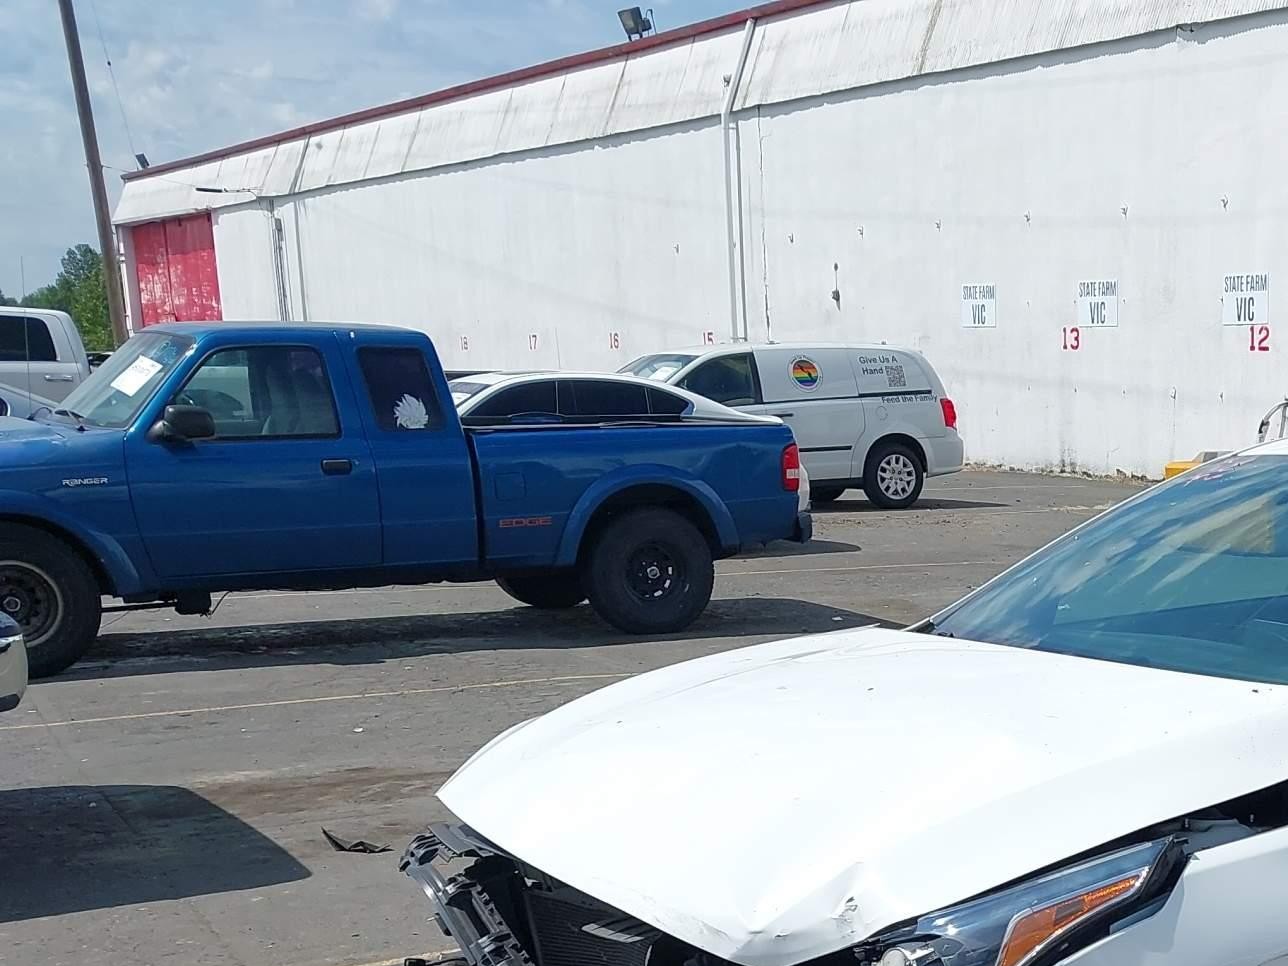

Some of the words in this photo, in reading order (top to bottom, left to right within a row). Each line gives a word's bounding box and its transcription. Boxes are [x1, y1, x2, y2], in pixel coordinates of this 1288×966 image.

[1079, 282, 1096, 297] STATE
[1099, 281, 1116, 296] FARM
[1224, 276, 1244, 292] STATE
[1246, 274, 1267, 291] FARM
[963, 286, 978, 299] STATE
[979, 285, 995, 299] FARM
[972, 304, 986, 324] VIC
[1090, 301, 1106, 324] VIC
[1236, 297, 1255, 321] VIC
[529, 335, 538, 350] 17
[609, 333, 619, 349] 16
[1063, 327, 1080, 350] 13
[1249, 326, 1270, 351] 12
[858, 356, 877, 364] Give
[879, 355, 890, 363] Us
[862, 367, 884, 375] Hand
[881, 395, 900, 404] Feed
[901, 395, 914, 403] the
[499, 516, 552, 528] EDGE
